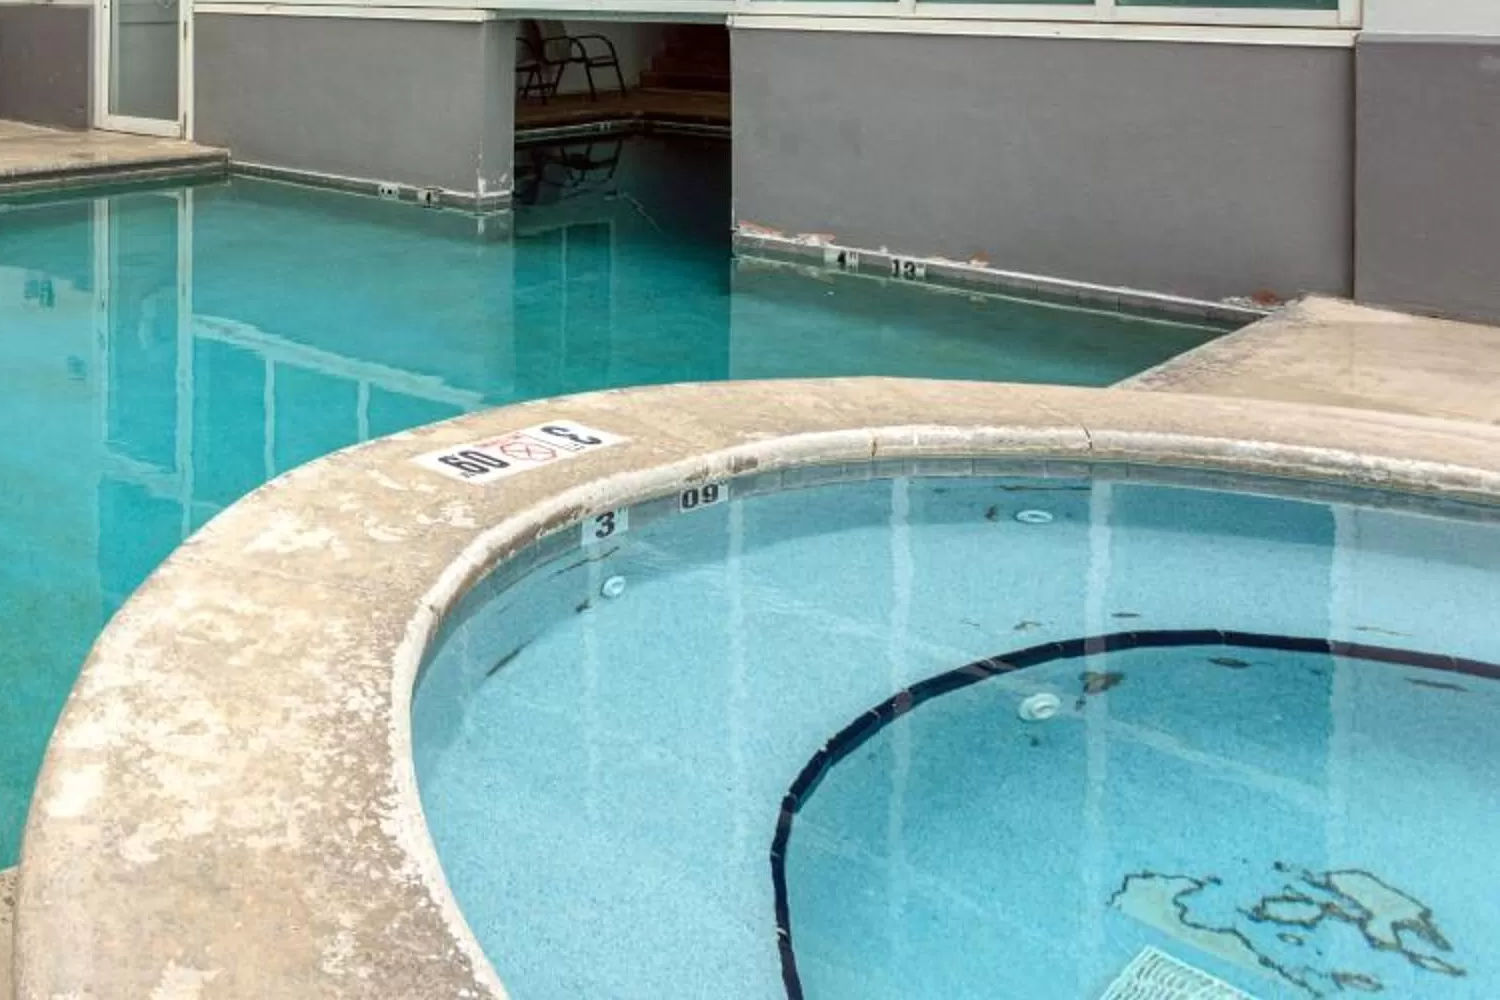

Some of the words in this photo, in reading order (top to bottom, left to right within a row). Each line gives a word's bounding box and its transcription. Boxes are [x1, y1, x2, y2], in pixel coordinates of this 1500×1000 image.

[540, 425, 602, 445] 3
[595, 511, 615, 539] 3
[682, 483, 719, 509] 09
